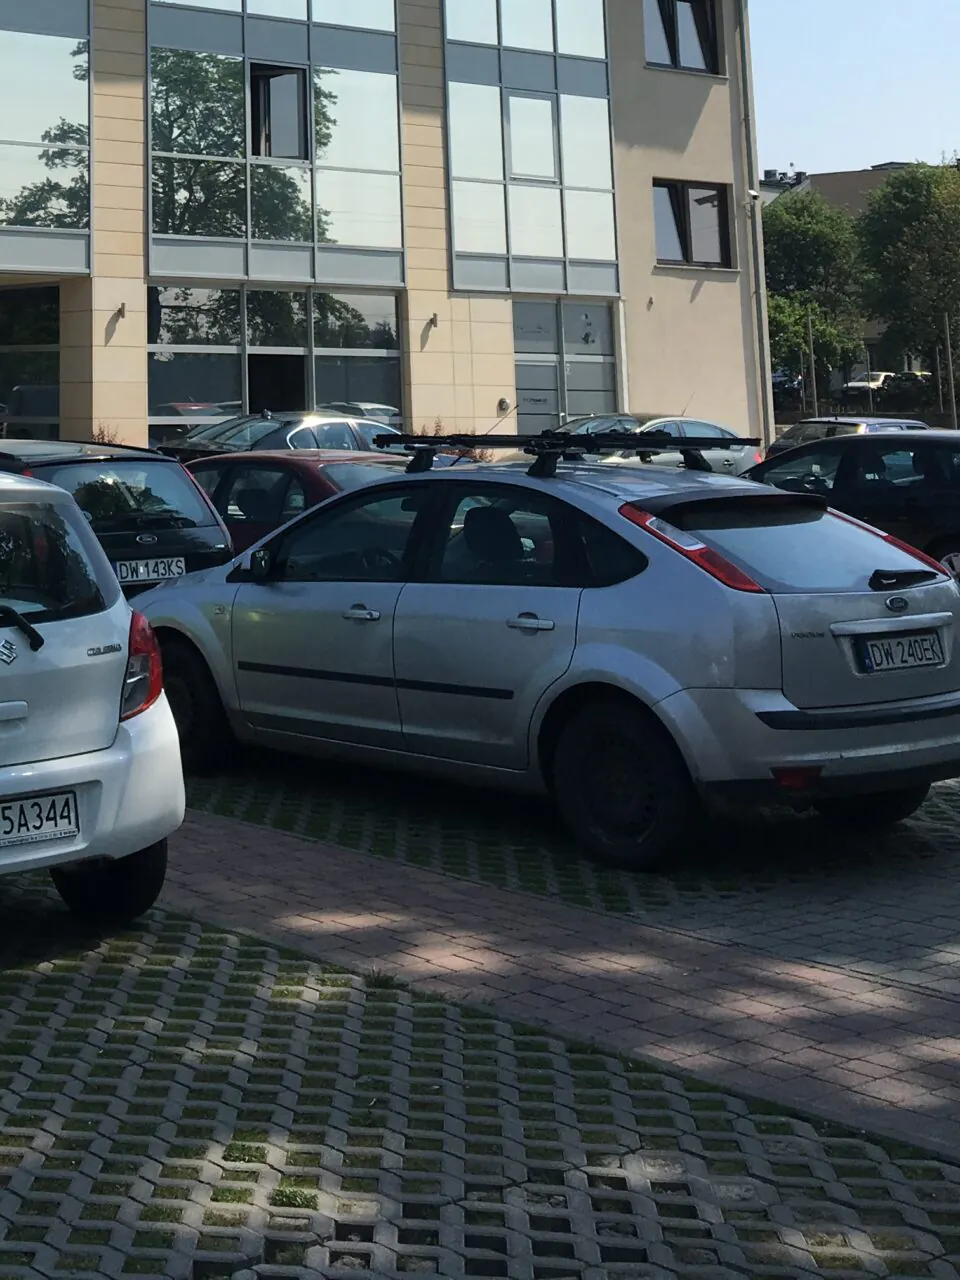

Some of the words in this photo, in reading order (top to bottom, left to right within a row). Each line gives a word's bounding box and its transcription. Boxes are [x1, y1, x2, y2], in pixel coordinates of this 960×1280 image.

[120, 561, 139, 579] DW
[145, 559, 185, 577] 143KS
[870, 642, 894, 667] DW
[897, 638, 940, 663] 240EK
[1, 797, 72, 835] 5A344
